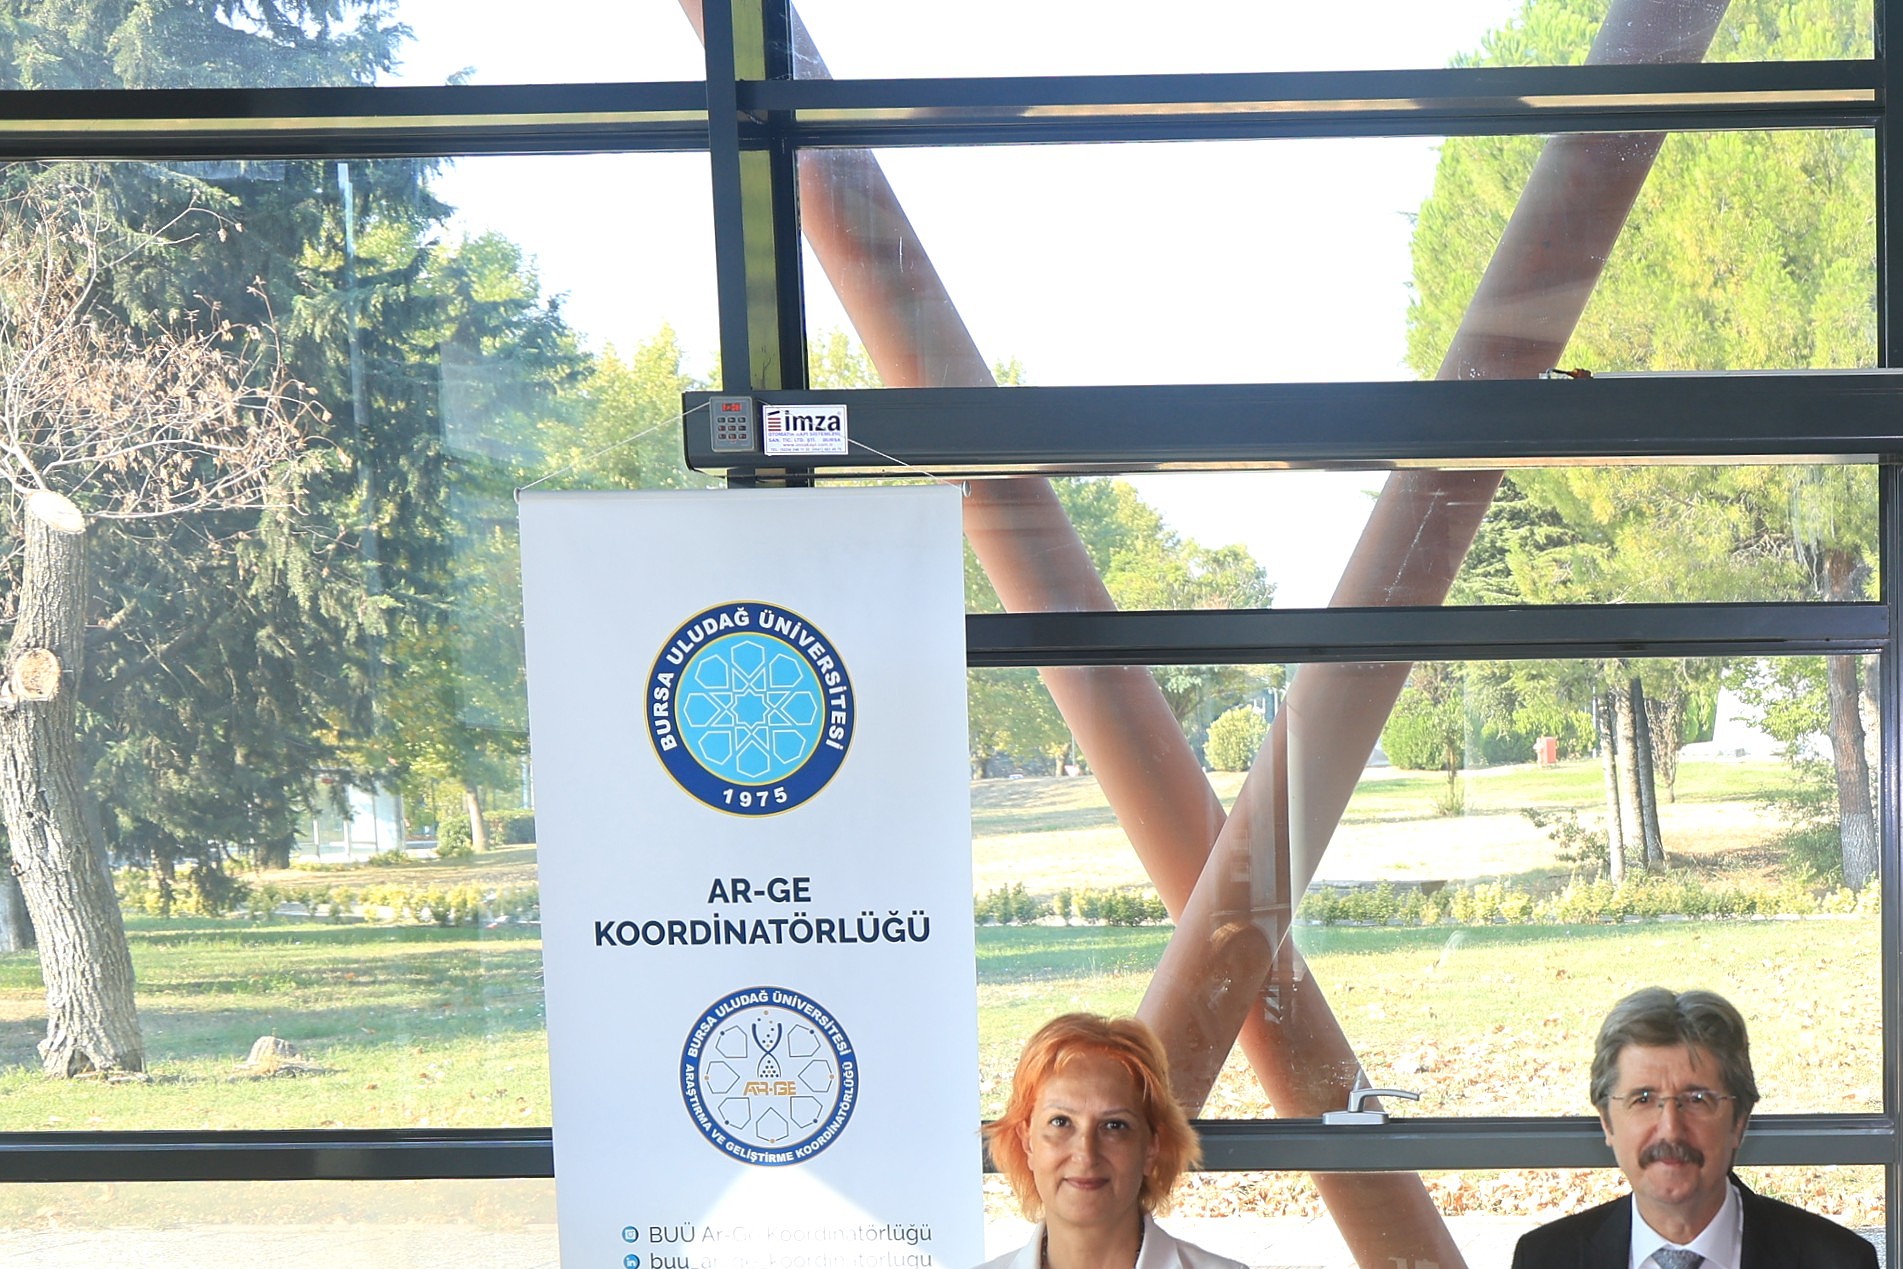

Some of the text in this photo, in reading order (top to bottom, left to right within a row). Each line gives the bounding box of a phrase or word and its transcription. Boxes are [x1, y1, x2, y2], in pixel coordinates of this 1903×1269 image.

[785, 410, 841, 432] imza
[653, 607, 847, 751] BURSA ULUDAĞ ÜNİVERSİTESİ
[723, 787, 787, 807] 1975
[707, 877, 812, 904] AR-GE
[594, 910, 931, 947] KOORDİNATÖRLÜĞÜ
[688, 990, 851, 1057] BURSA ULUDAĞ ÜNİVERSİTESİ
[685, 1061, 854, 1163] ARAŞTIRMA VE GELİŞTİRME KOORDİNATÖRLÜĞÜ
[649, 1221, 695, 1243] BUÜ
